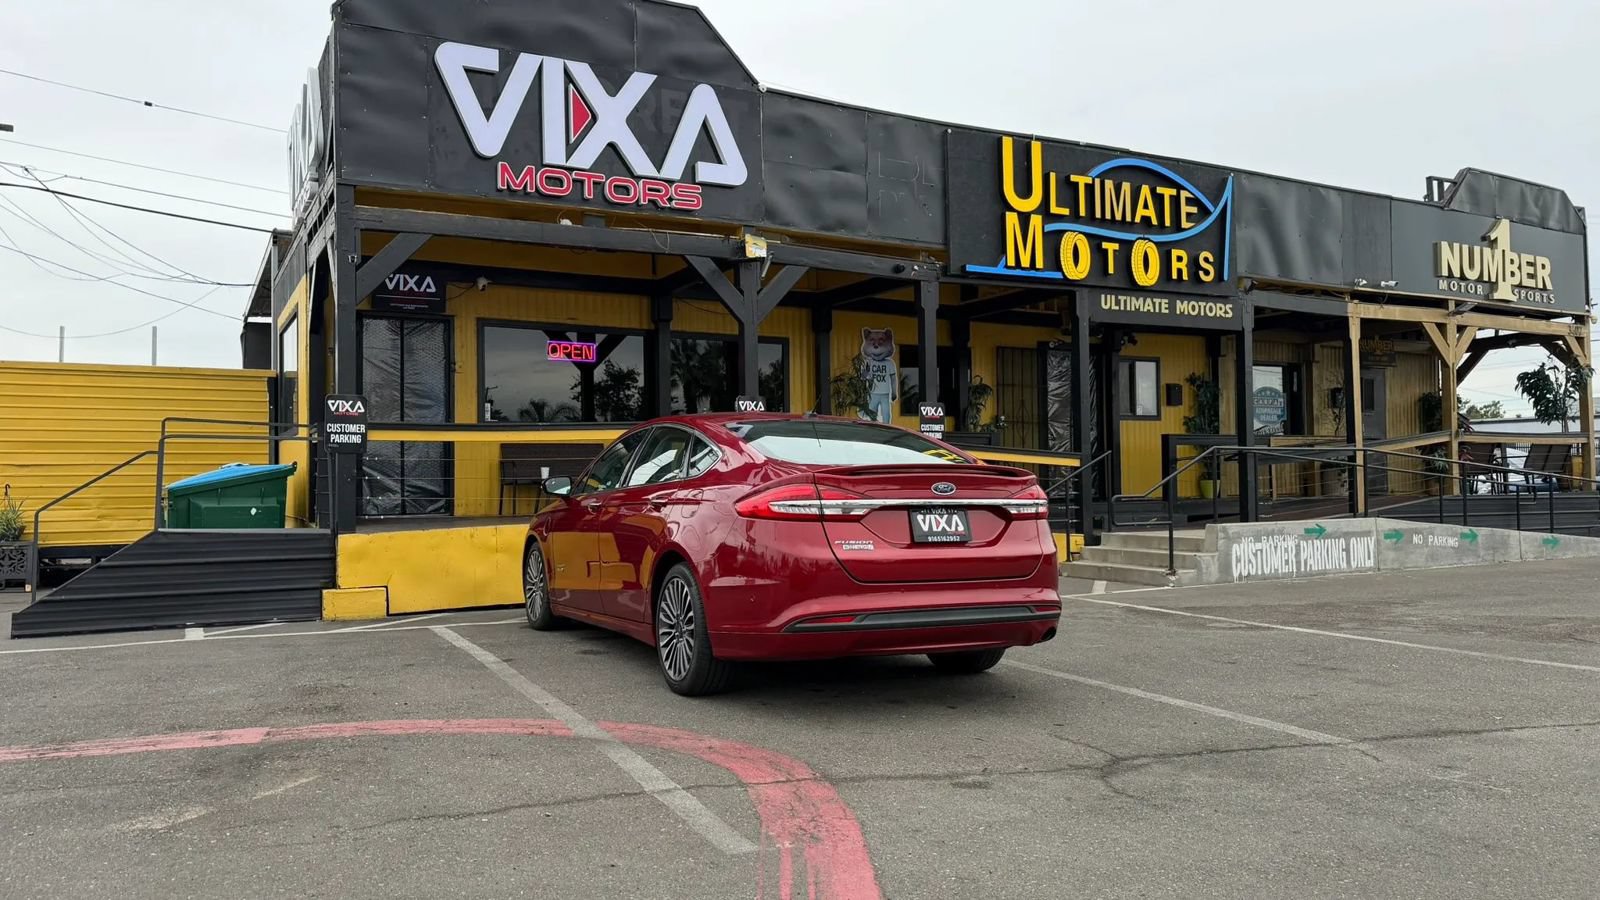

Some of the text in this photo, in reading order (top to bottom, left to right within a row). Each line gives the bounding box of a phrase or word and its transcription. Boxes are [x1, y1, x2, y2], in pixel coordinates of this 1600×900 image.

[434, 41, 748, 186] VIXA
[497, 162, 703, 211] MOTORS
[1001, 135, 1199, 229] ULTIMATE
[1005, 211, 1216, 287] MOTORS
[1438, 240, 1553, 290] NUMBER
[385, 273, 437, 293] VIXA
[1438, 279, 1556, 304] MOTOR SPORTS
[1101, 294, 1233, 318] ULTIMATE MOTORS
[548, 343, 593, 360] OPEN
[871, 364, 887, 374] CAR
[872, 374, 886, 383] FOX
[327, 400, 365, 413] VIXA
[739, 400, 765, 411] VIXA
[920, 406, 944, 416] VIXA
[327, 423, 366, 433] CUSTOMER
[920, 424, 945, 432] CUSTOMER
[330, 433, 362, 444] PARKING
[916, 514, 965, 532] VIXA
[1412, 533, 1459, 548] NO PARKING
[1231, 536, 1376, 577] CUSTOMER PARKING ONLY
